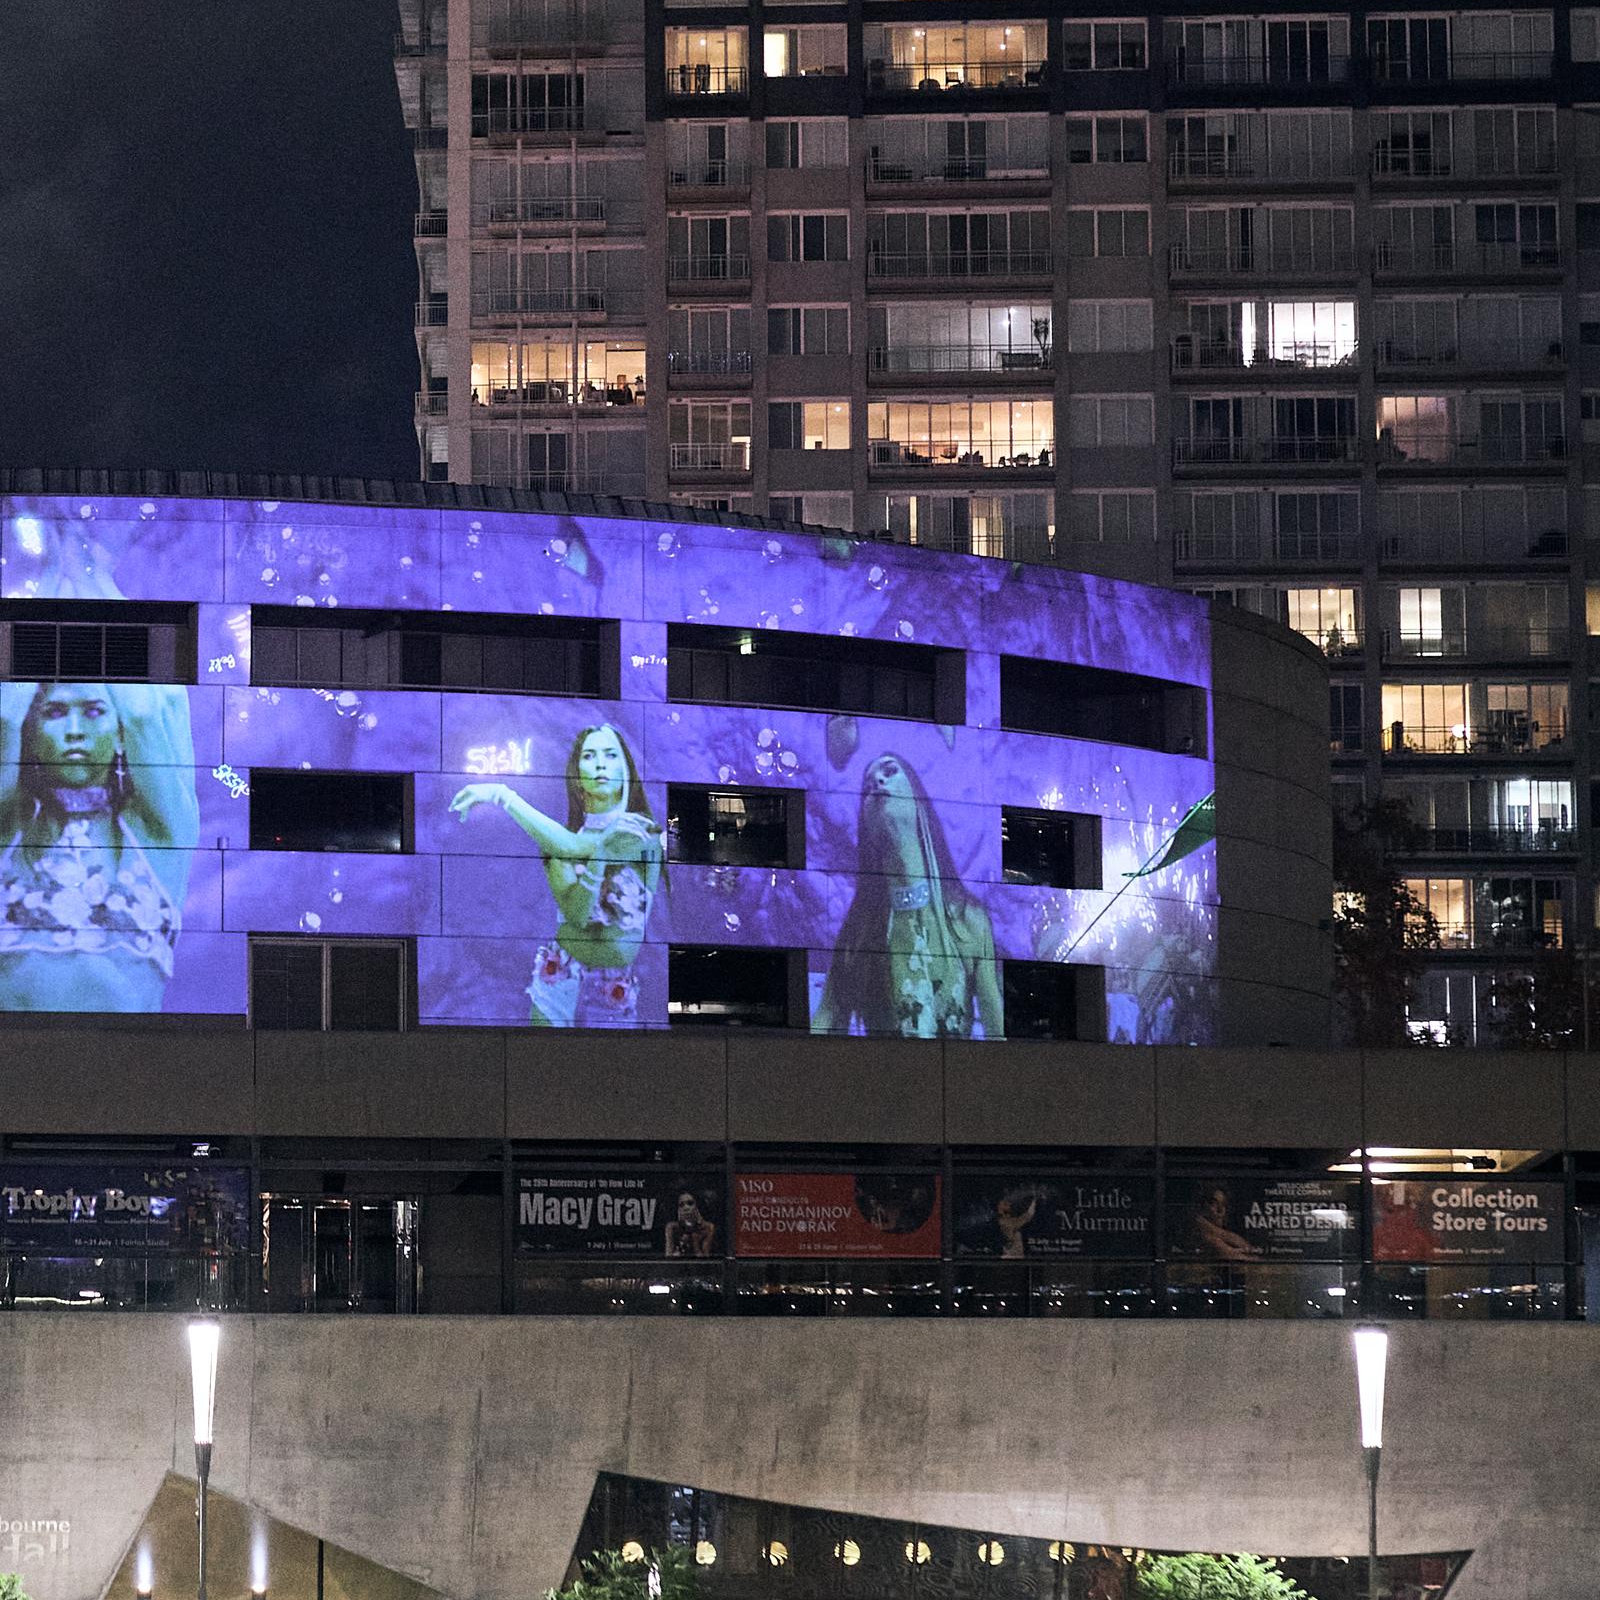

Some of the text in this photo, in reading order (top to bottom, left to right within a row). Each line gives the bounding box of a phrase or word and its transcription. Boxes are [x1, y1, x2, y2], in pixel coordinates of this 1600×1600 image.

[740, 1179, 774, 1193] MSO
[1, 1187, 171, 1217] Trophy Boys
[1075, 1187, 1132, 1209] Little
[1250, 1202, 1262, 1215] A
[1432, 1188, 1538, 1210] Collection
[519, 1192, 656, 1230] Macy Gray
[740, 1206, 852, 1219] RACHMANINOV
[1055, 1210, 1150, 1232] Murmur
[1433, 1210, 1548, 1232] Store Tours
[740, 1220, 773, 1232] AND
[1244, 1217, 1300, 1229] NAMED
